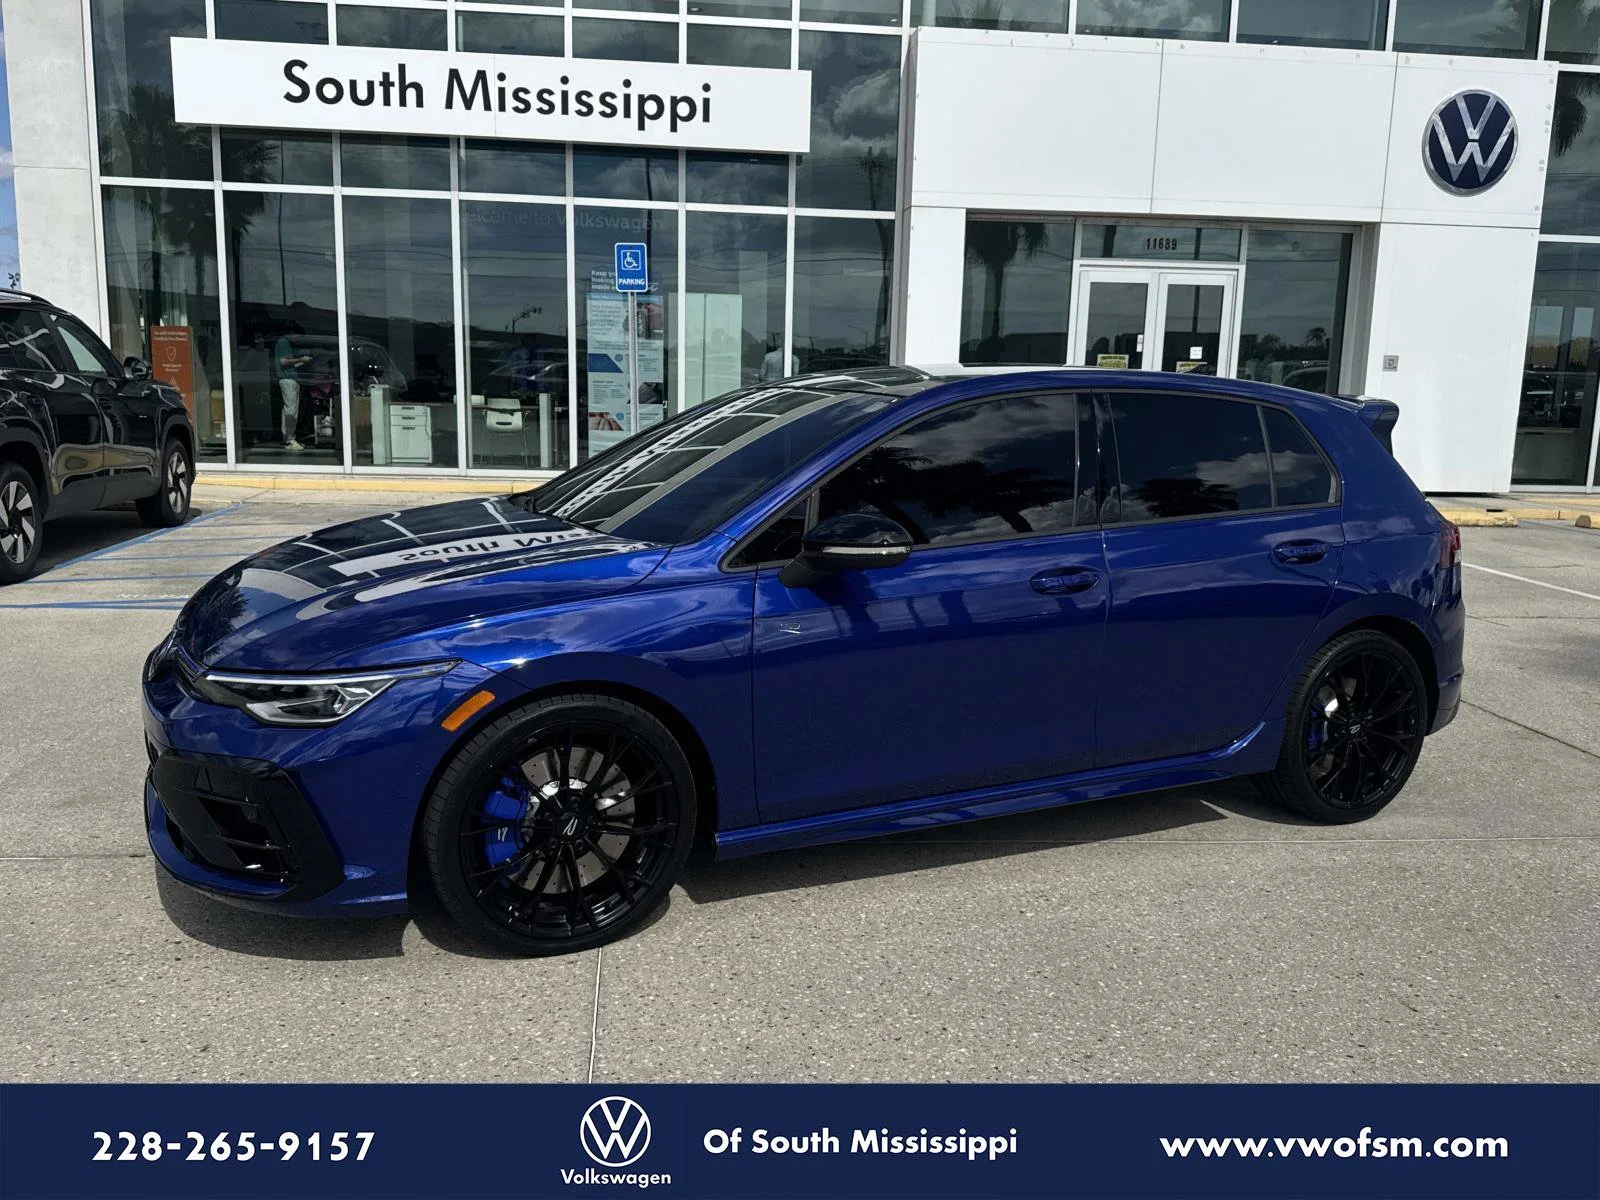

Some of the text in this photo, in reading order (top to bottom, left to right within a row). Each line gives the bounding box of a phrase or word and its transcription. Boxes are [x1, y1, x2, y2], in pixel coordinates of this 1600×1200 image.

[283, 58, 711, 133] South Mississippi
[1424, 90, 1518, 193] VW
[1146, 237, 1177, 250] 11689
[618, 277, 645, 286] PARKING
